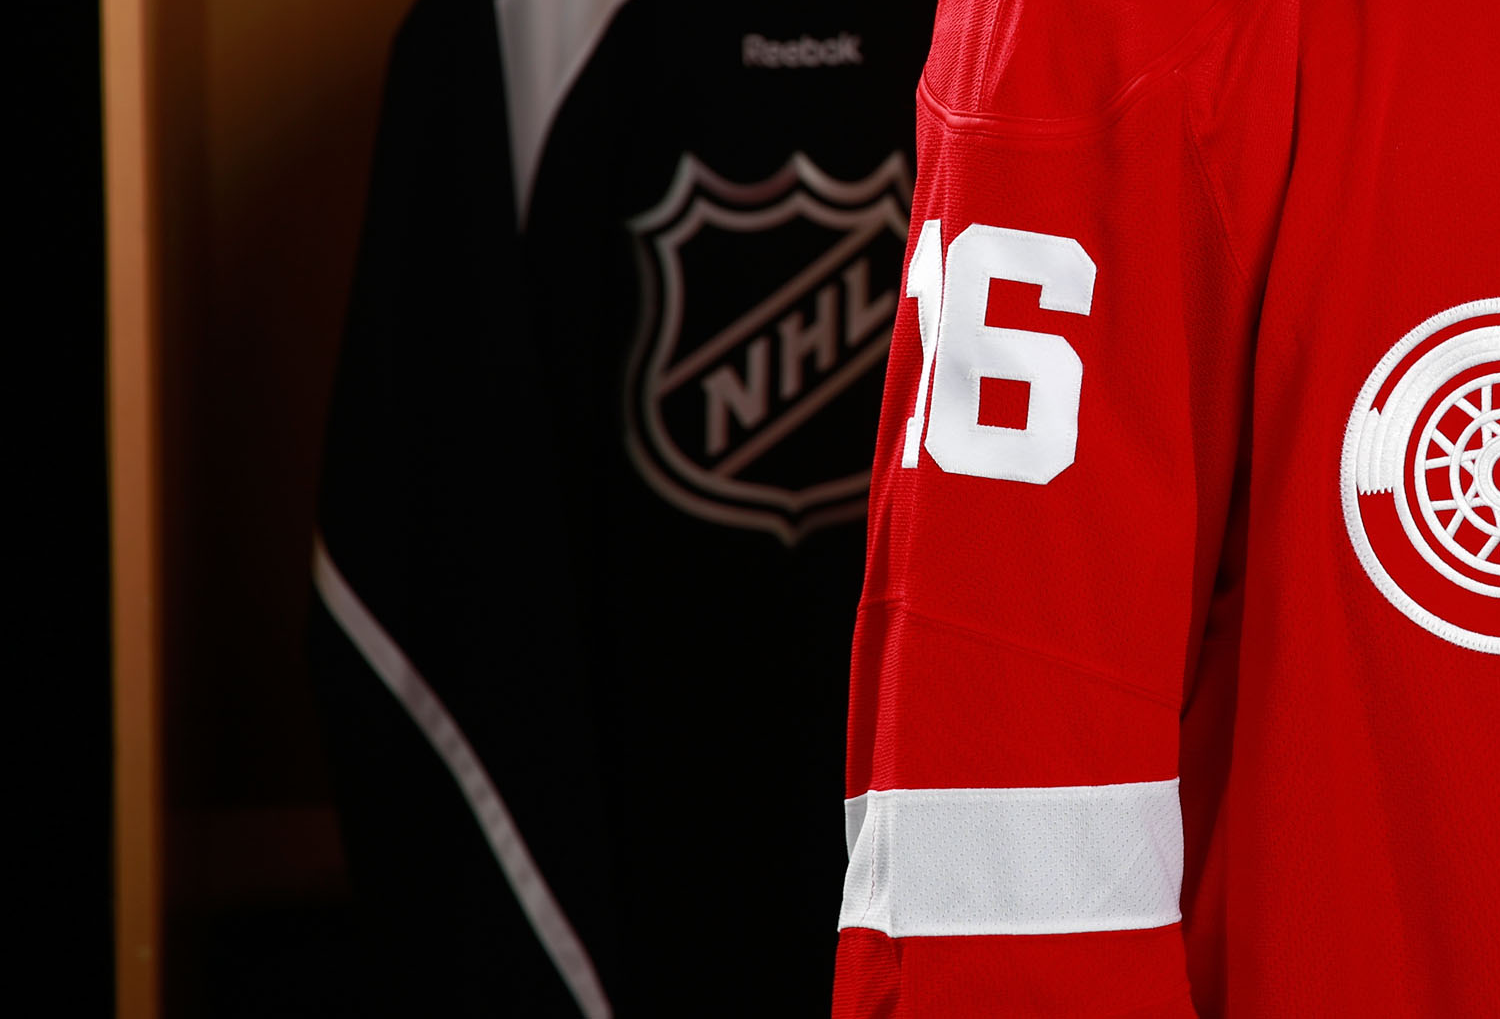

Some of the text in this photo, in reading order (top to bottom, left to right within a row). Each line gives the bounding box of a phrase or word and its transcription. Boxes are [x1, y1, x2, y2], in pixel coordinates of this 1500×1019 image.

[742, 32, 863, 68] Reebok
[702, 257, 898, 456] NHL
[902, 219, 1097, 485] 16
